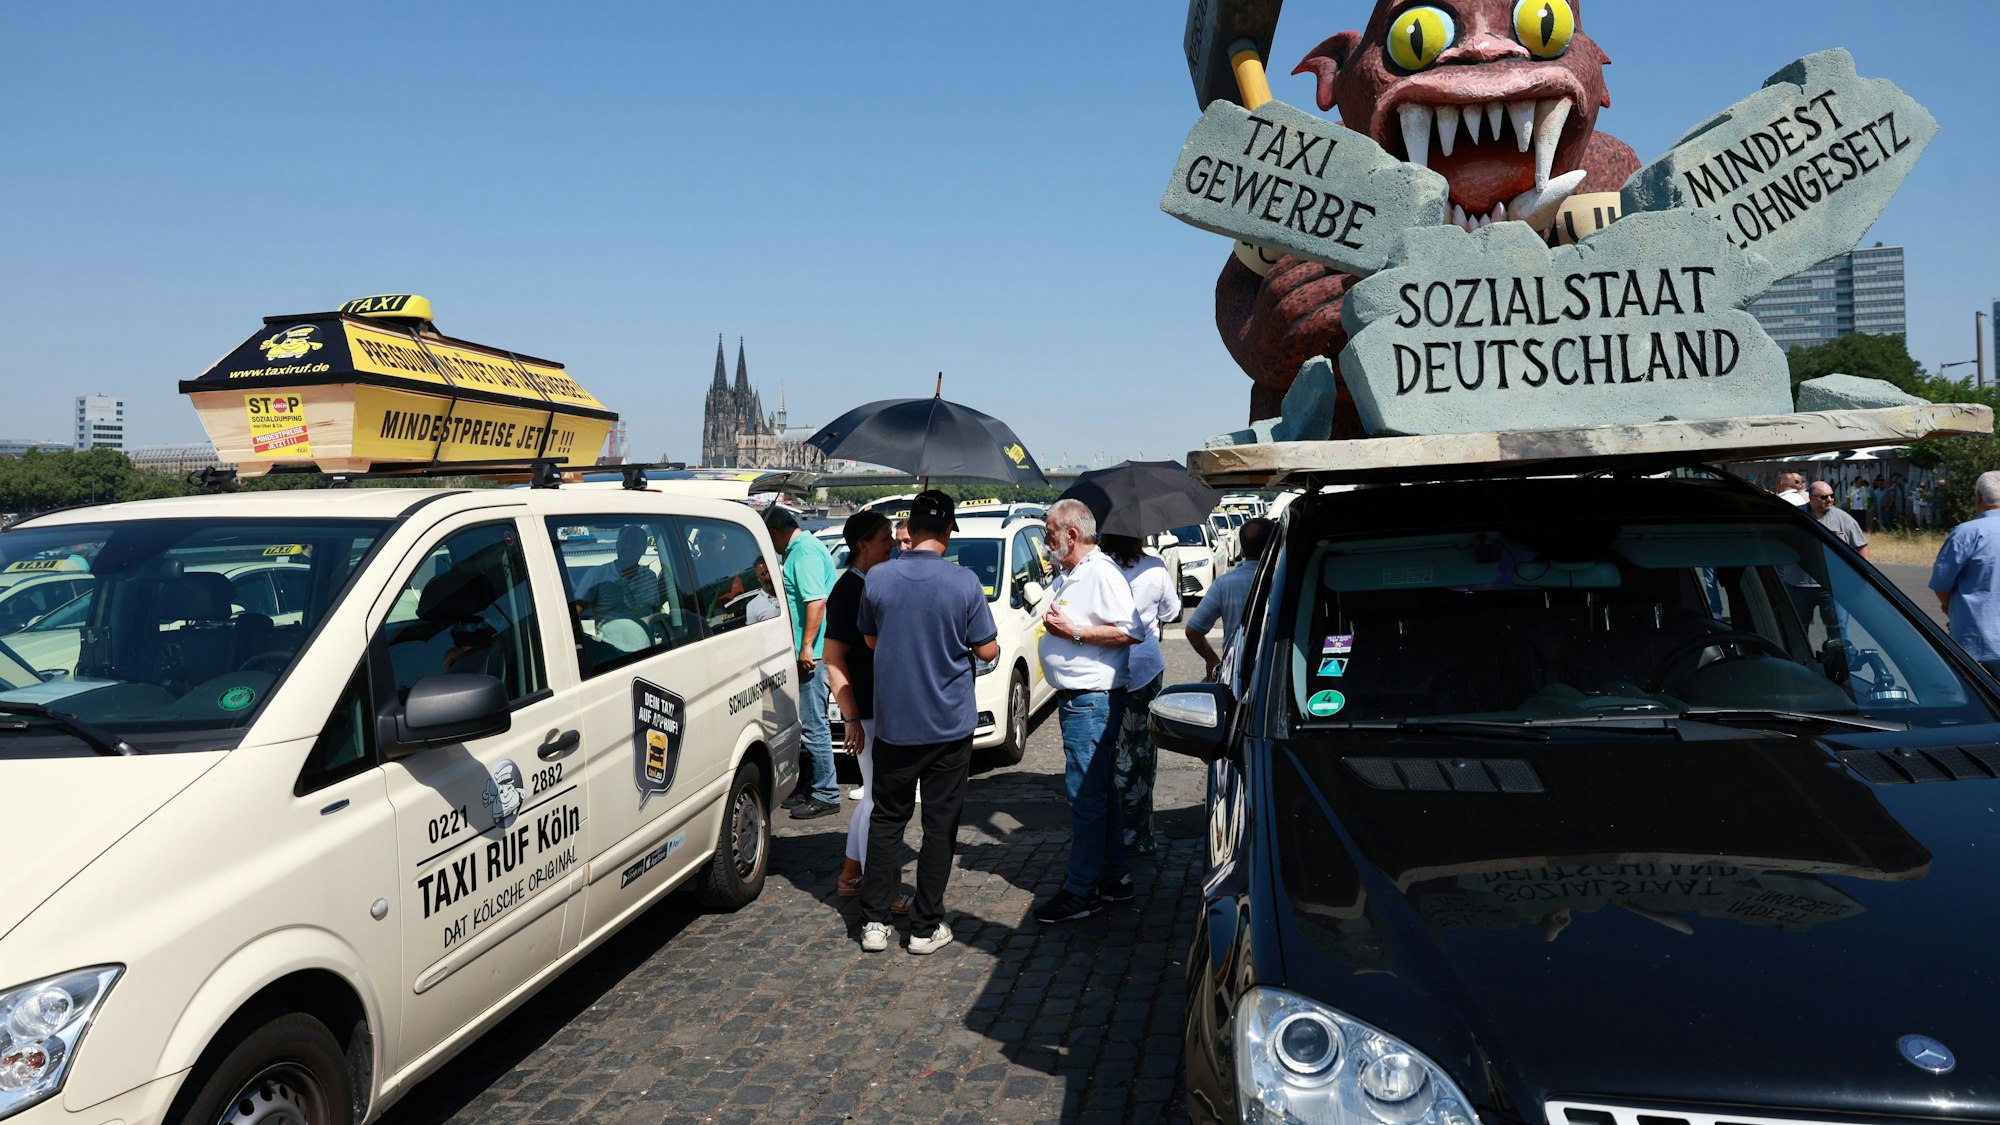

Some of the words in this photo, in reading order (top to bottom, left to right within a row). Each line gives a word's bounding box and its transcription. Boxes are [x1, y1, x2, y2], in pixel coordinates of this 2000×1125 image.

[1246, 115, 1338, 180] TAXI
[1683, 89, 1843, 208] MINDEST
[1185, 155, 1376, 250] GEWERBE
[348, 296, 404, 313] TAXI
[1394, 266, 1716, 329] SOZIALSTAAT
[229, 363, 330, 379] www.taxiruf.de
[355, 338, 465, 380] PREISDUMPNG
[452, 352, 499, 385] TÖTET
[487, 364, 521, 389] DAS
[1392, 328, 1740, 396] DEUTSCHLAND
[256, 426, 304, 443] MINDESTPREISE
[268, 440, 286, 449] JETZT
[380, 410, 516, 448] MINDESTPREISE
[516, 425, 558, 452] JETT
[21, 560, 53, 569] TAXI
[644, 691, 660, 710] DEIN
[660, 699, 675, 717] TAXI
[1321, 690, 1332, 703] 4
[638, 706, 652, 724] AUF
[652, 712, 679, 735] APPRUF!
[428, 805, 469, 844] 0221
[531, 762, 563, 796] 2882
[417, 852, 477, 919] TAXI
[486, 824, 530, 883] RUF
[537, 804, 580, 854] Köln
[444, 914, 469, 949] DAT
[473, 878, 526, 930] KÖLSCHE
[528, 845, 578, 891] ORIGINAL
